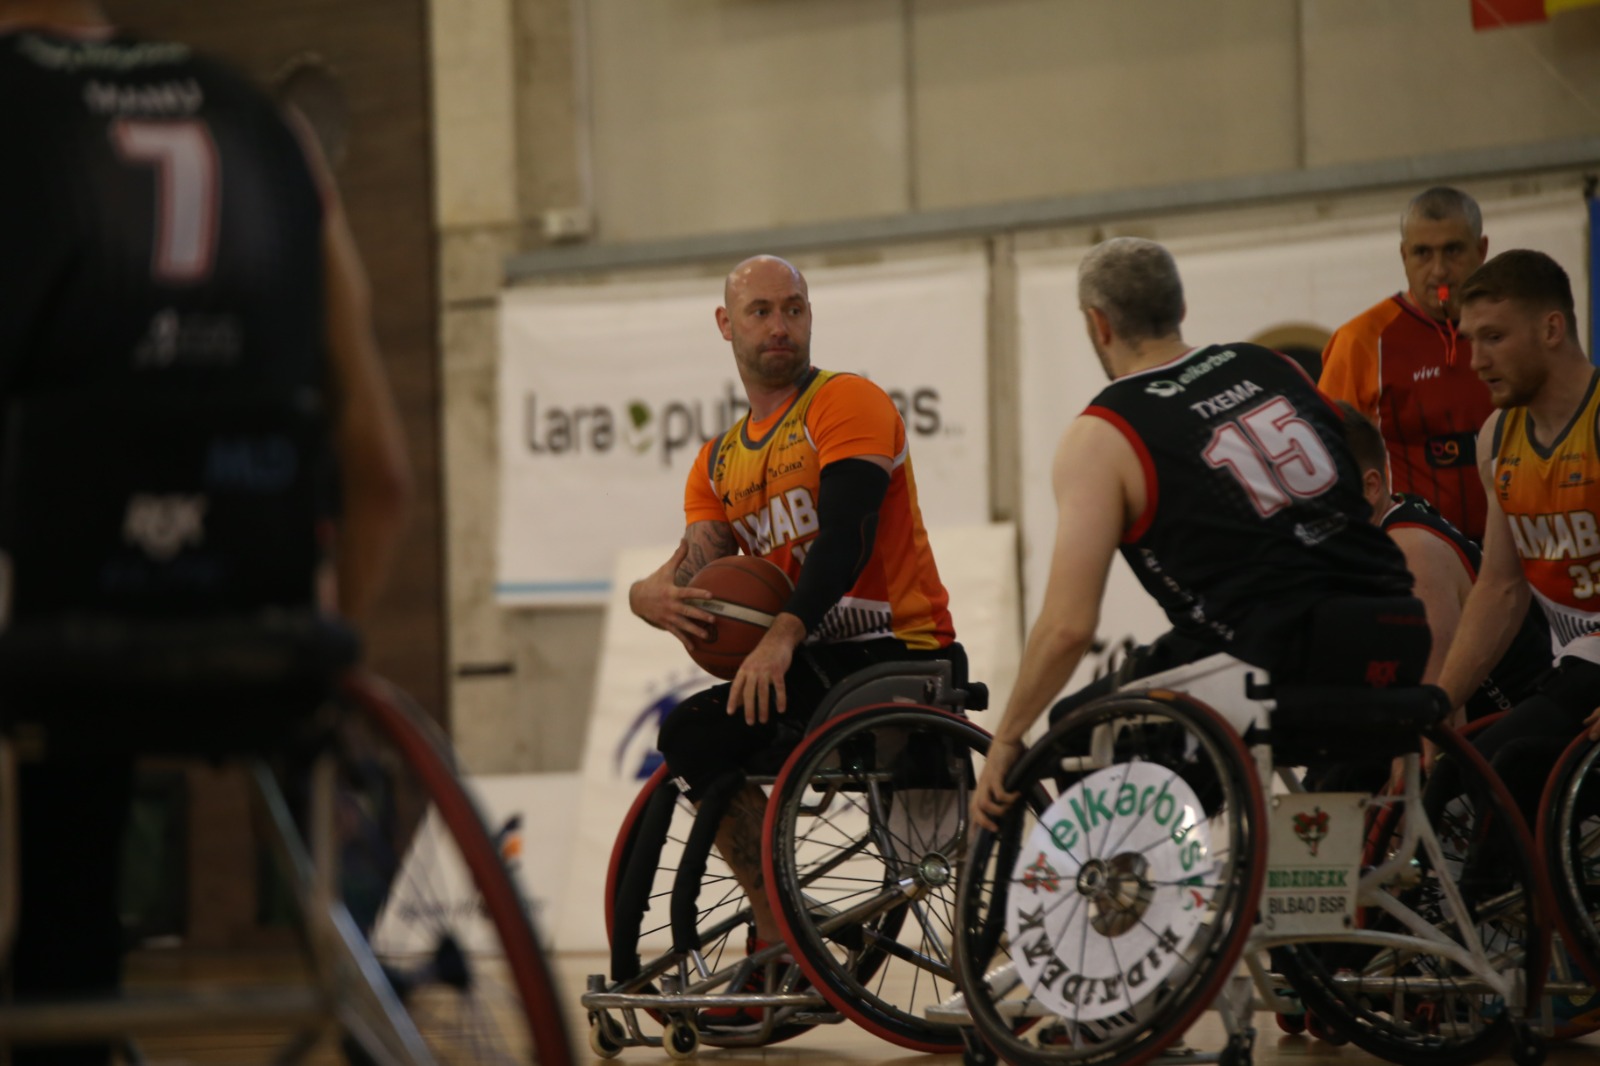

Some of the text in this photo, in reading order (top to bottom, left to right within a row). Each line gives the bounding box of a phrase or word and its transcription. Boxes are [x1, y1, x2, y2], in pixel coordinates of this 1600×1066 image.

[109, 118, 222, 284] 7
[524, 393, 613, 454] lara
[1189, 379, 1264, 420] TXEMA
[1202, 395, 1339, 518] 15
[1269, 896, 1346, 914] BILBAO BSR
